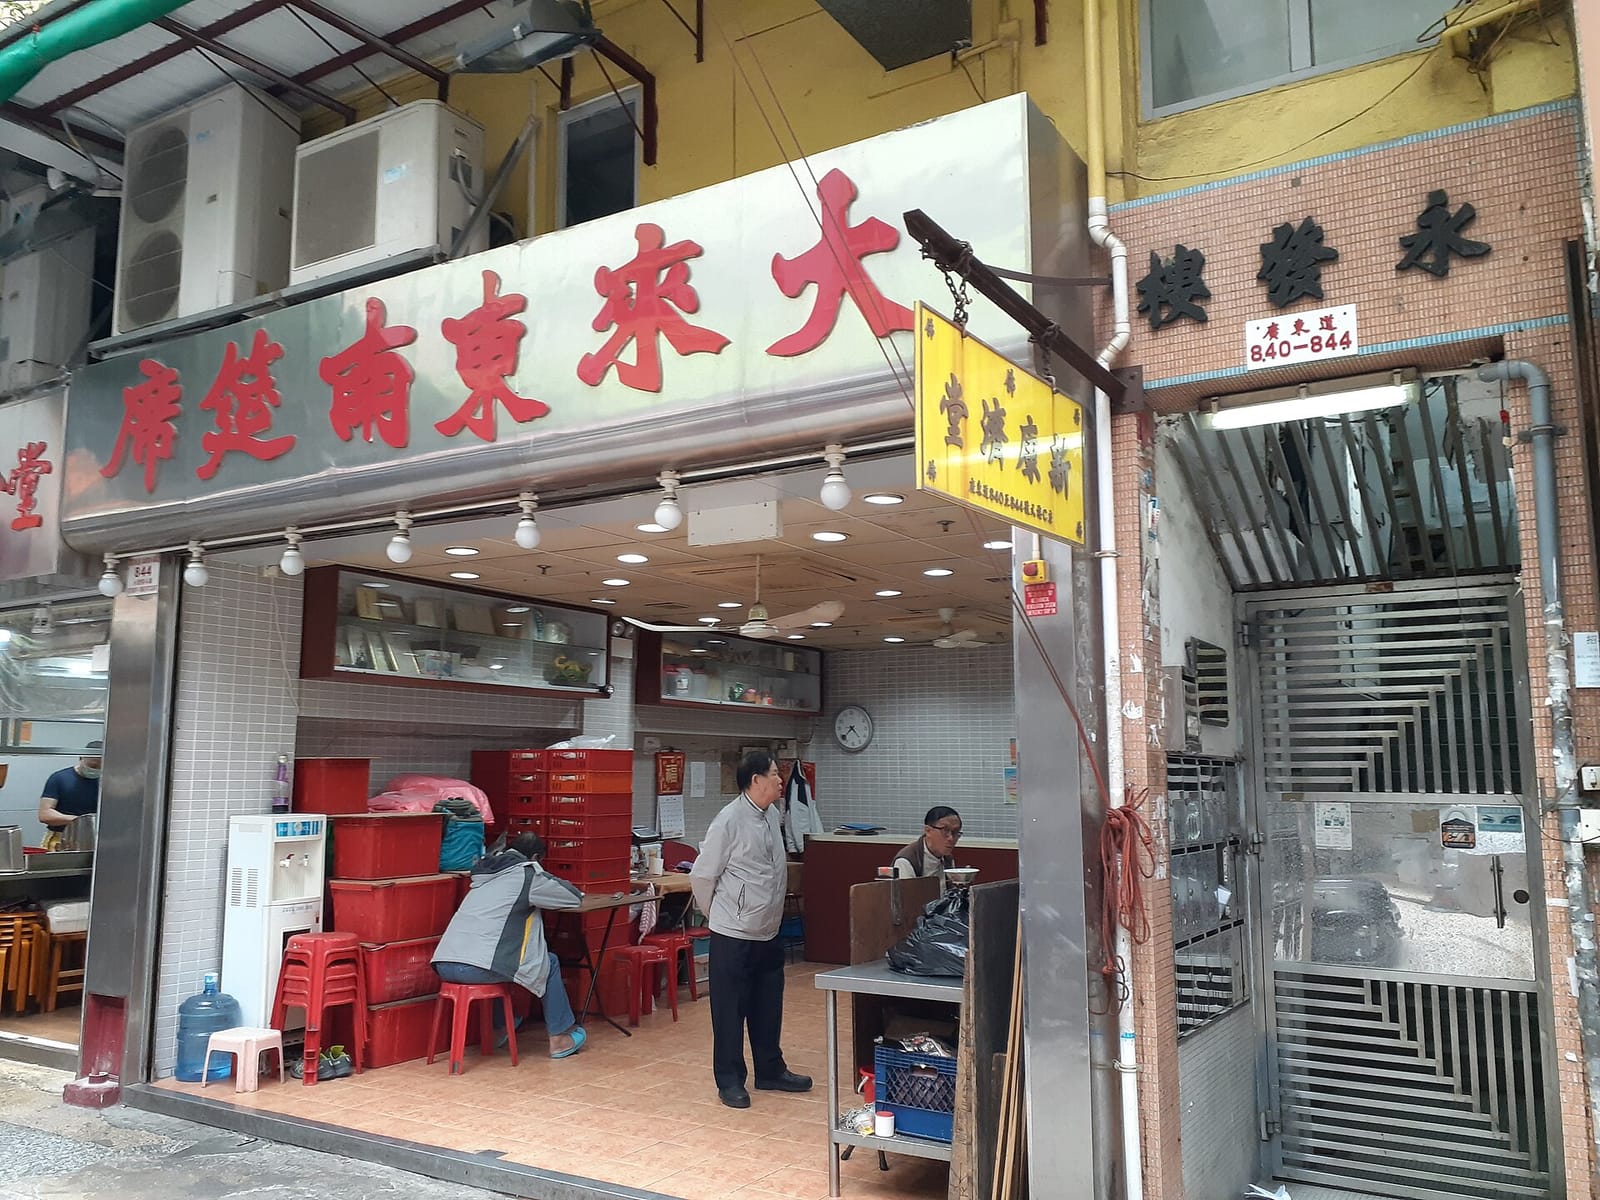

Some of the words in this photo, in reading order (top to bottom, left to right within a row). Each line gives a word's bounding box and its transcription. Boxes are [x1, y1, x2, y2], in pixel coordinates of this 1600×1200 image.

[1263, 314, 1337, 341] 廣東道
[134, 566, 153, 578] 844
